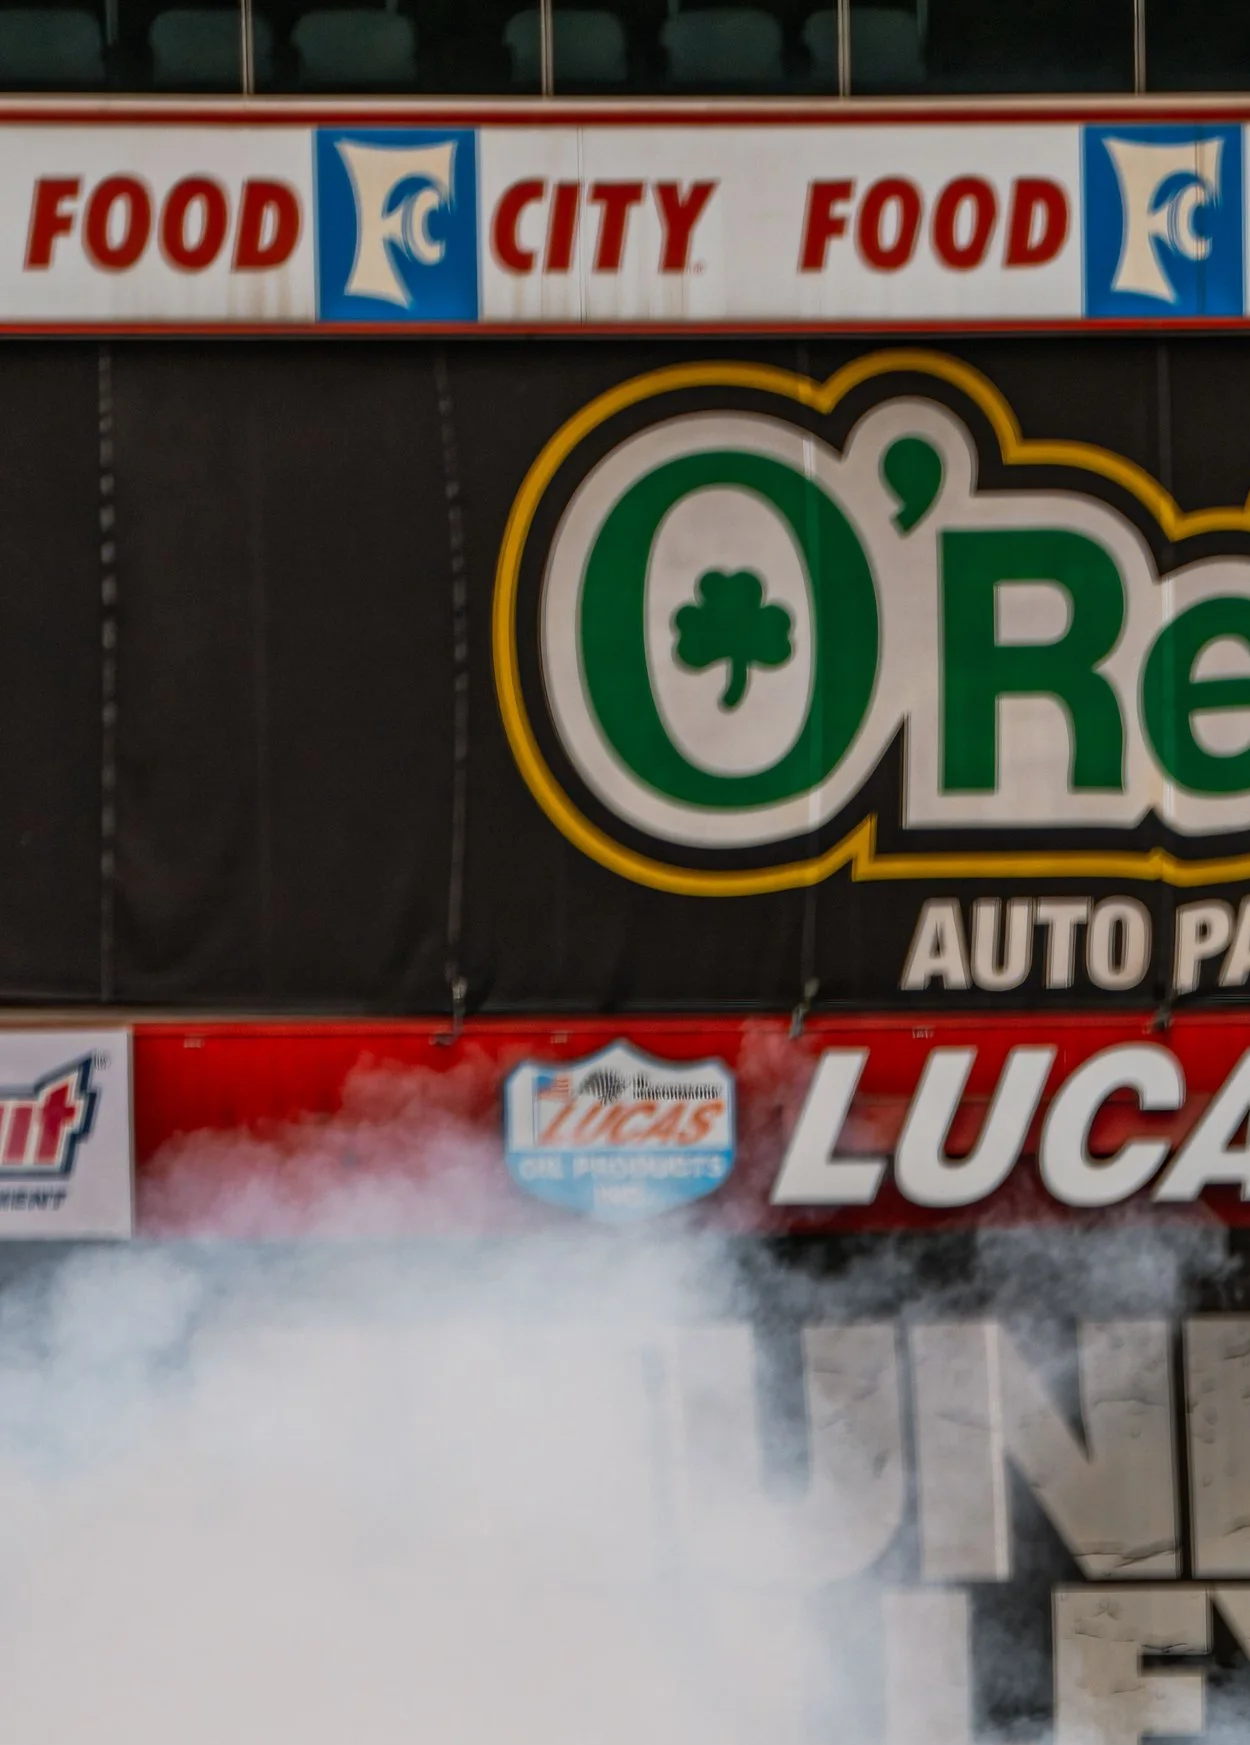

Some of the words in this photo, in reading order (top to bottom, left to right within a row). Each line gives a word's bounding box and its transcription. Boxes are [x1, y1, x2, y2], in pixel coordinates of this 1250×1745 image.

[24, 175, 301, 272] FOOD
[490, 179, 720, 274] CITY
[797, 178, 1070, 271] FOOD
[901, 895, 1151, 992] AUTO
[538, 1099, 725, 1146] LUCAS
